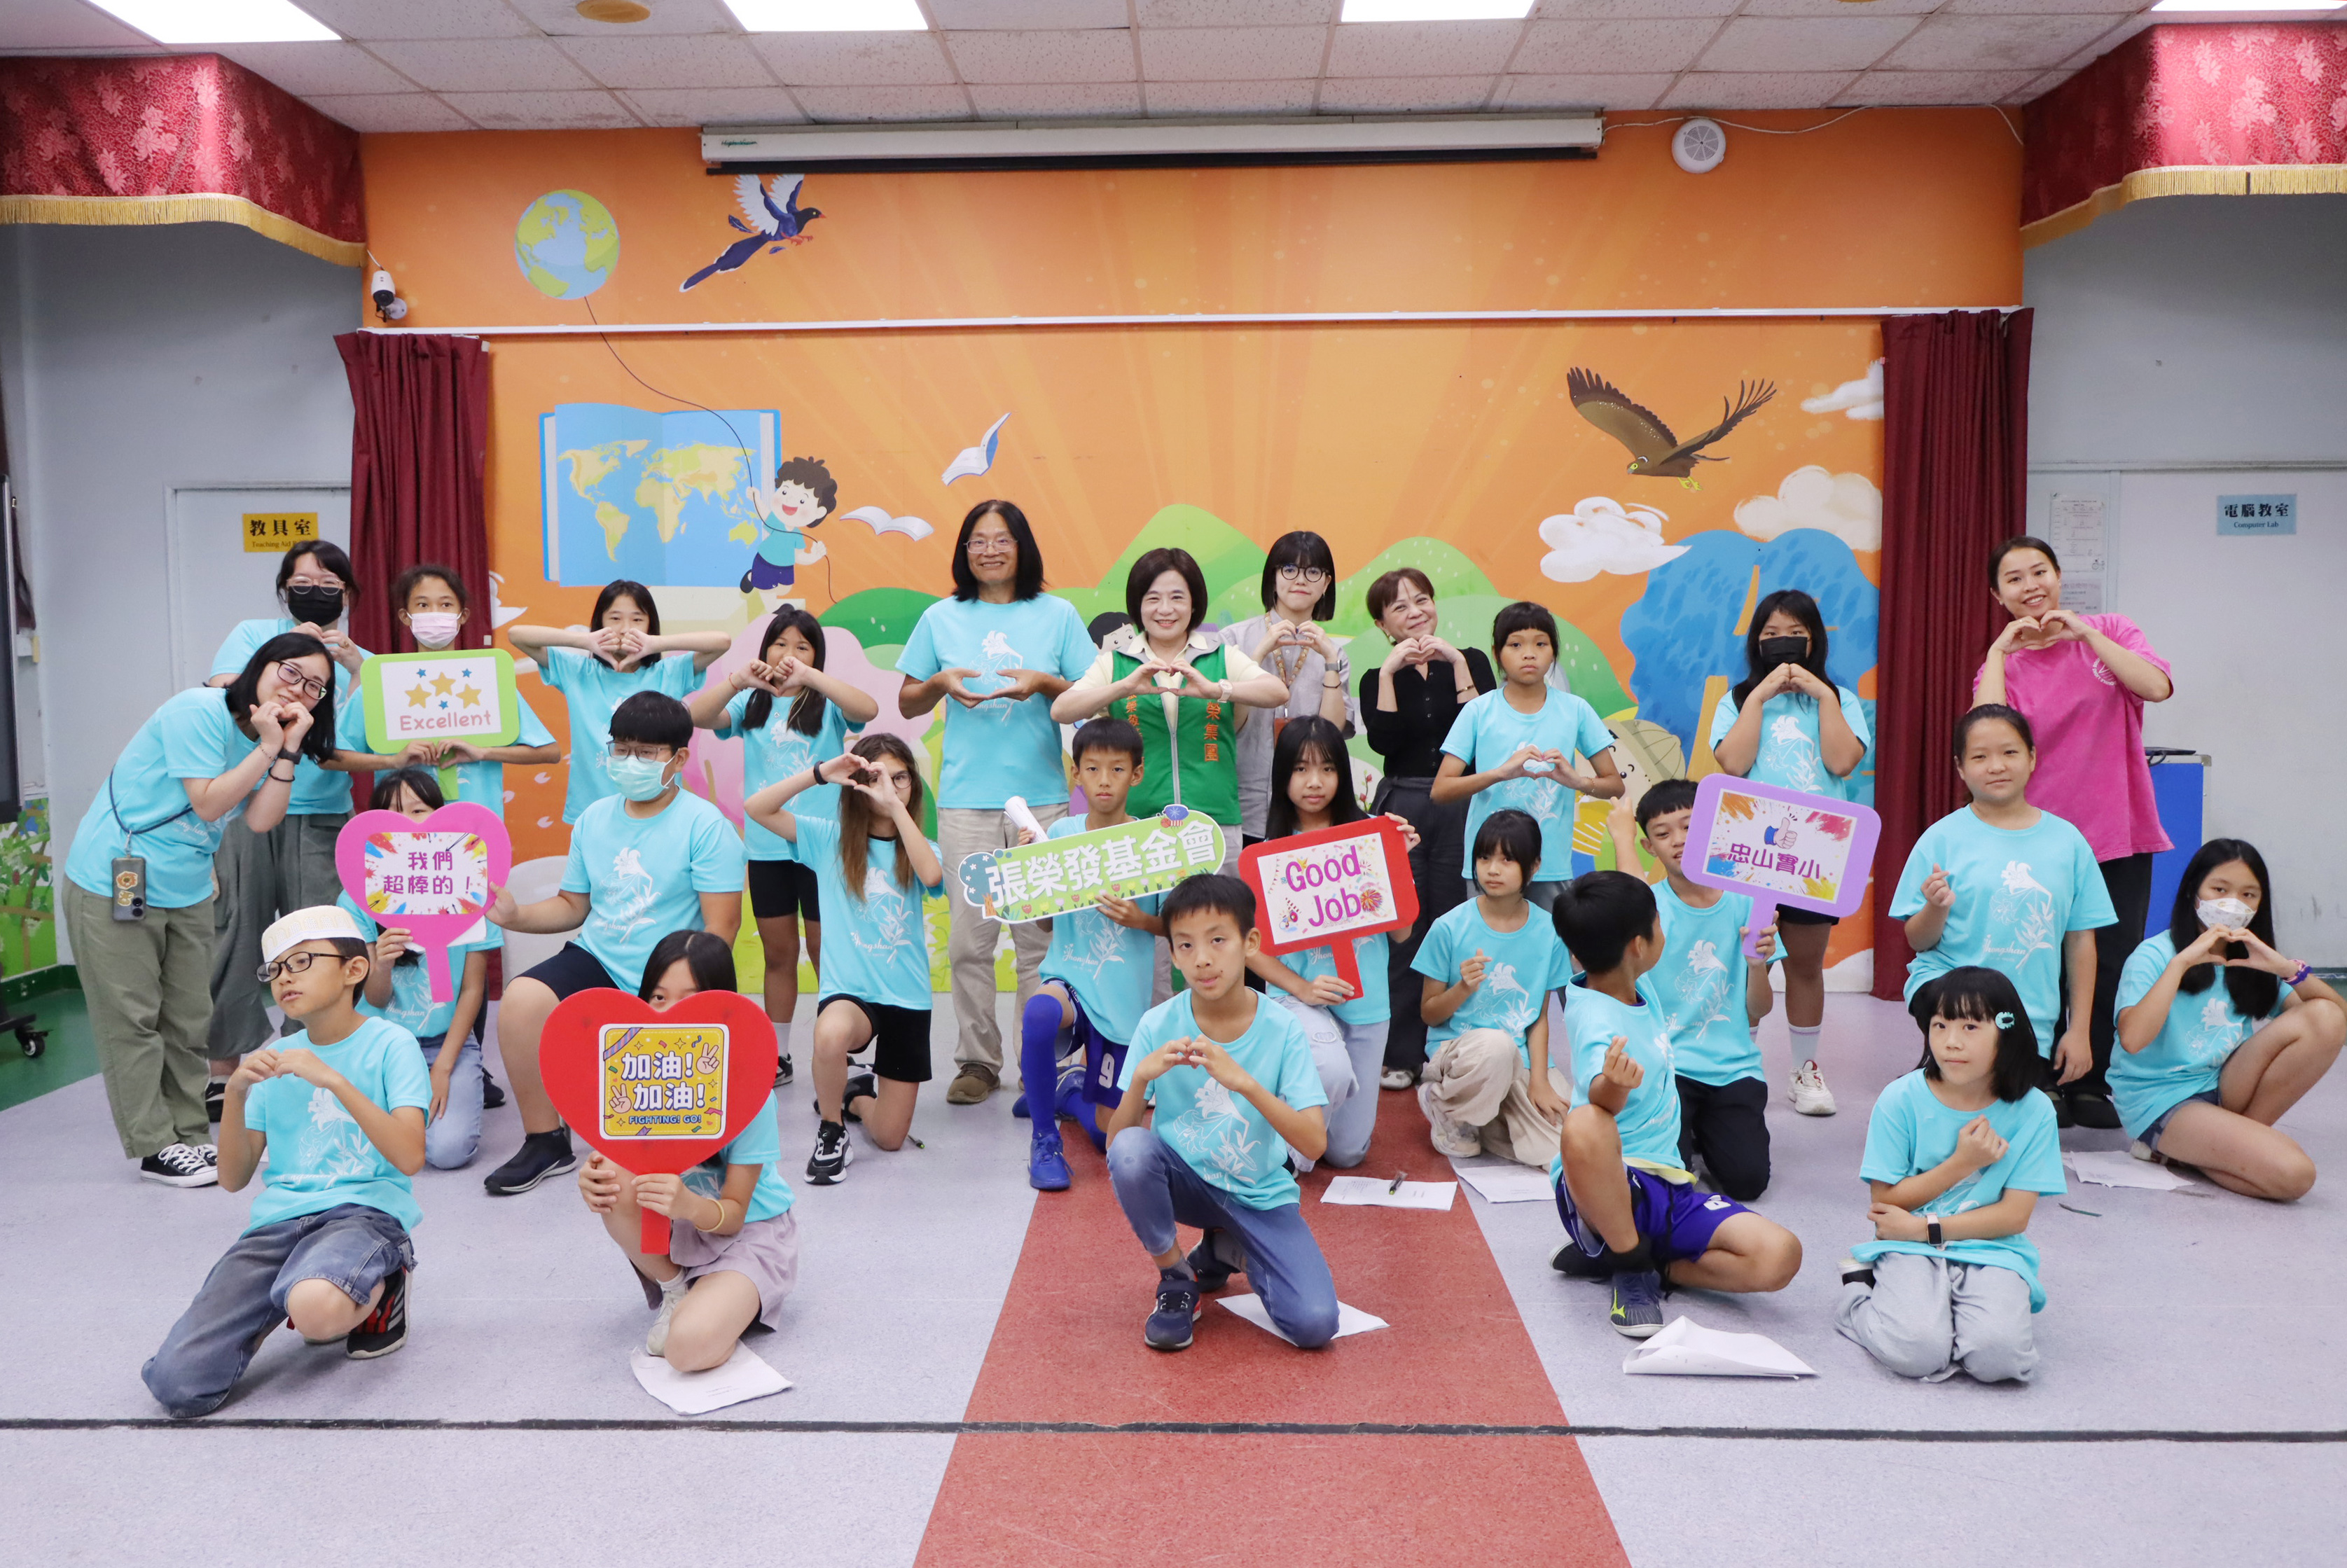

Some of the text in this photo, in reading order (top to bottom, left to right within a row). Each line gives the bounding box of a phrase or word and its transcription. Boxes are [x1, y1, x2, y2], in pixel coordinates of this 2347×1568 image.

[2224, 503, 2289, 518] 電腦教室
[249, 519, 311, 536] 教具室
[400, 710, 491, 731] Excellent
[1204, 701, 1221, 762] 榮集團
[408, 851, 453, 870] 我們
[985, 819, 1217, 908] 張榮發基金會
[1285, 845, 1361, 892] Good
[1727, 843, 1820, 879] 忠山實小
[1308, 888, 1362, 927] Job
[621, 1050, 693, 1081] 加油!
[1098, 1053, 1114, 1089] 9
[632, 1081, 705, 1111] 加油!
[628, 1115, 702, 1125] FIGHTING! GO!
